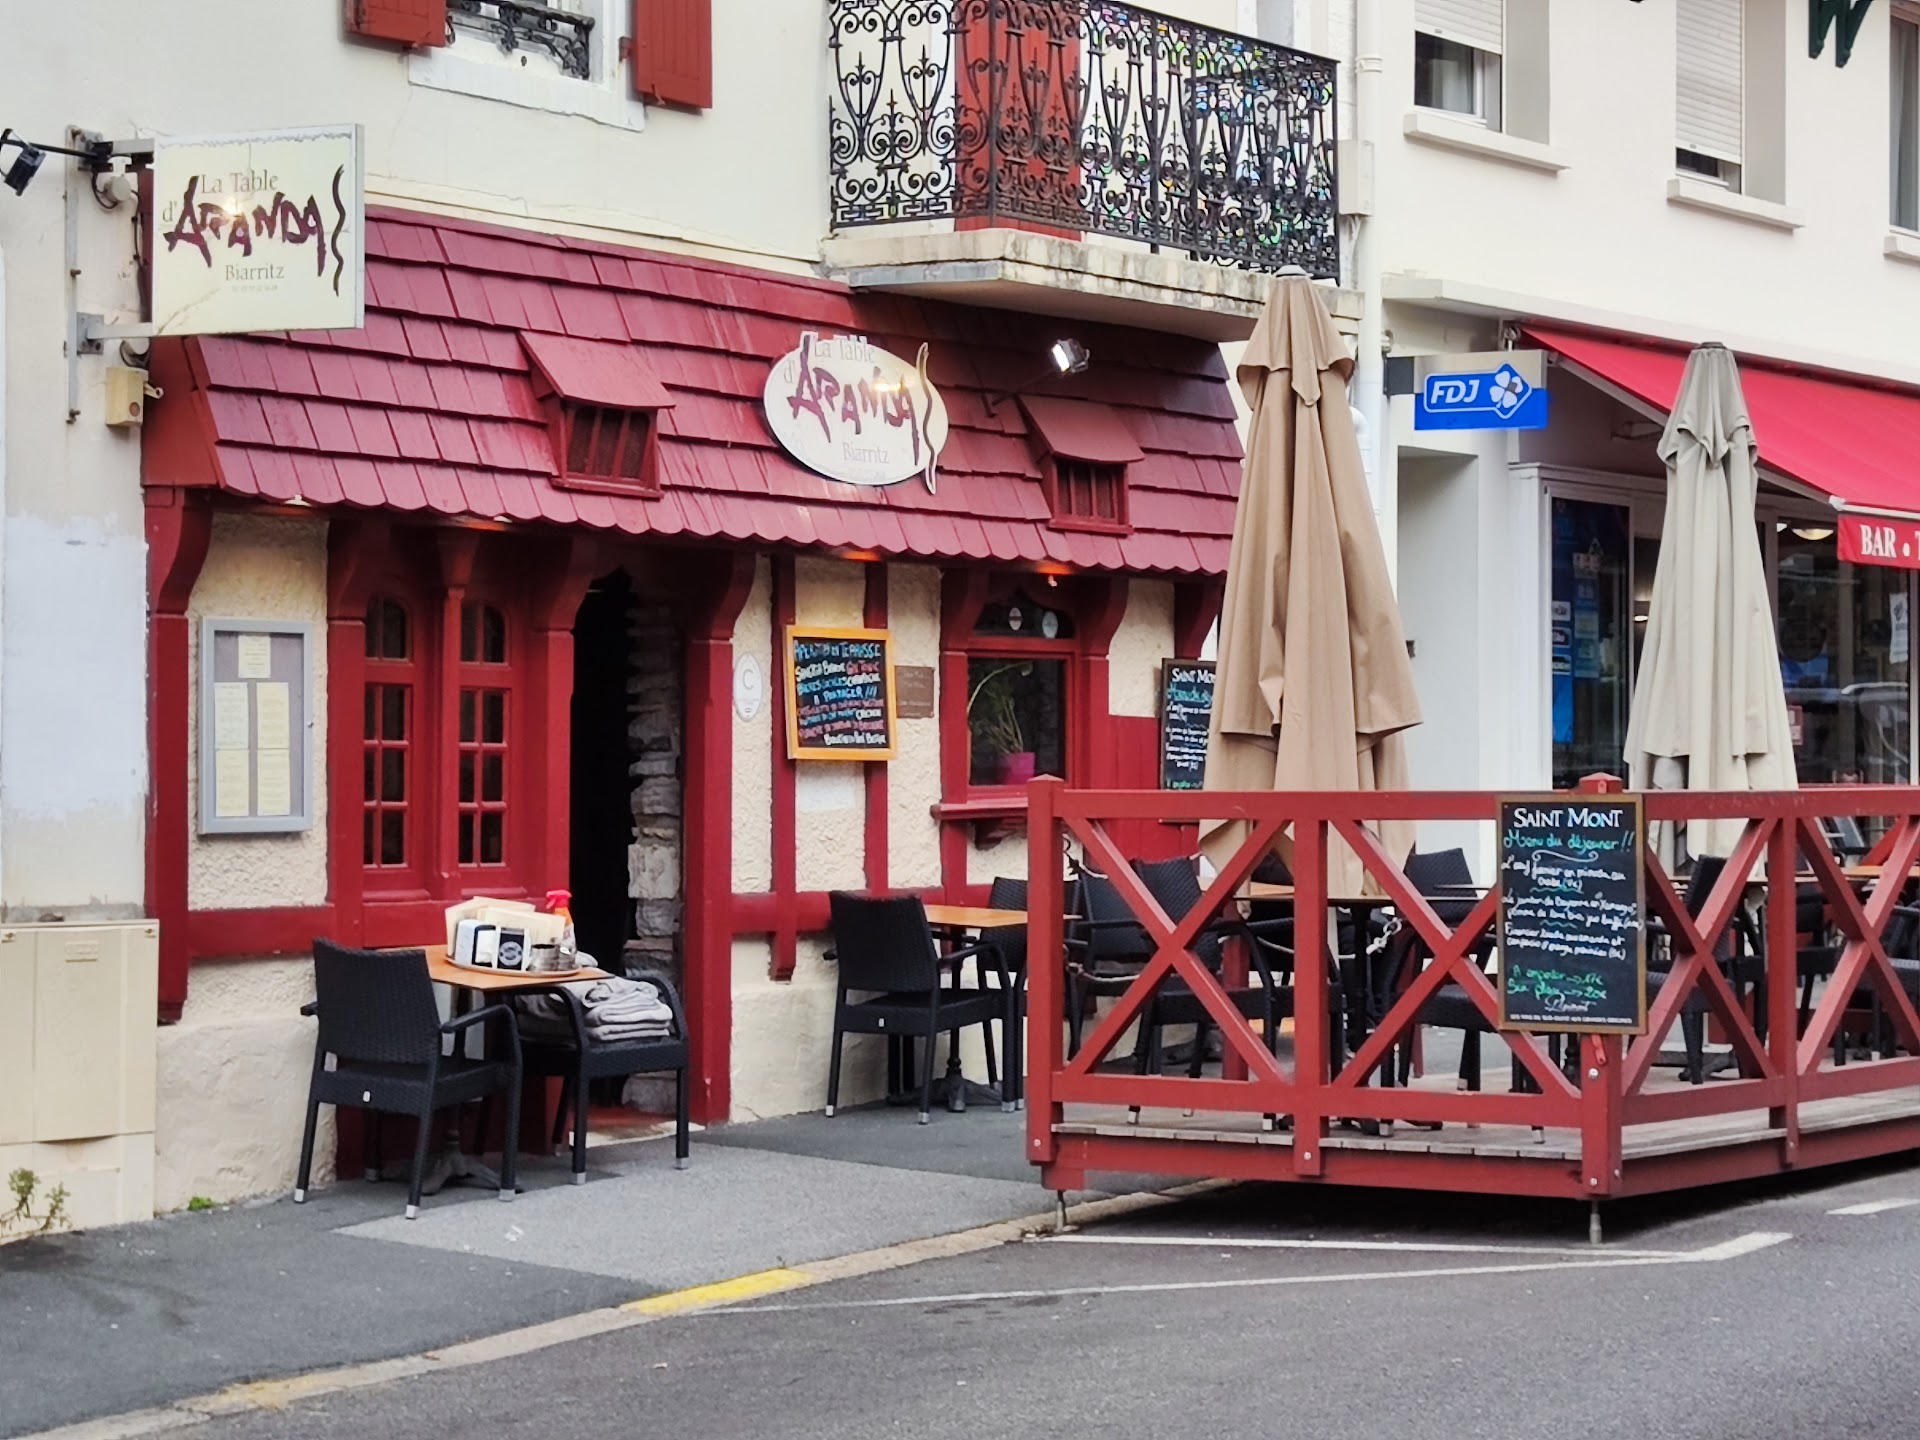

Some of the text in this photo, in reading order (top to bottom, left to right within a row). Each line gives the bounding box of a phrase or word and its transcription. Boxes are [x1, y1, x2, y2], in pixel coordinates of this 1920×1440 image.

[201, 169, 279, 194] La Table
[225, 264, 285, 281] Biarritz
[814, 335, 832, 358] La
[1430, 379, 1480, 405] FDJ
[842, 442, 890, 464] Biarritz
[1860, 524, 1897, 558] BAR
[1513, 807, 1624, 828] SAINT MONT
